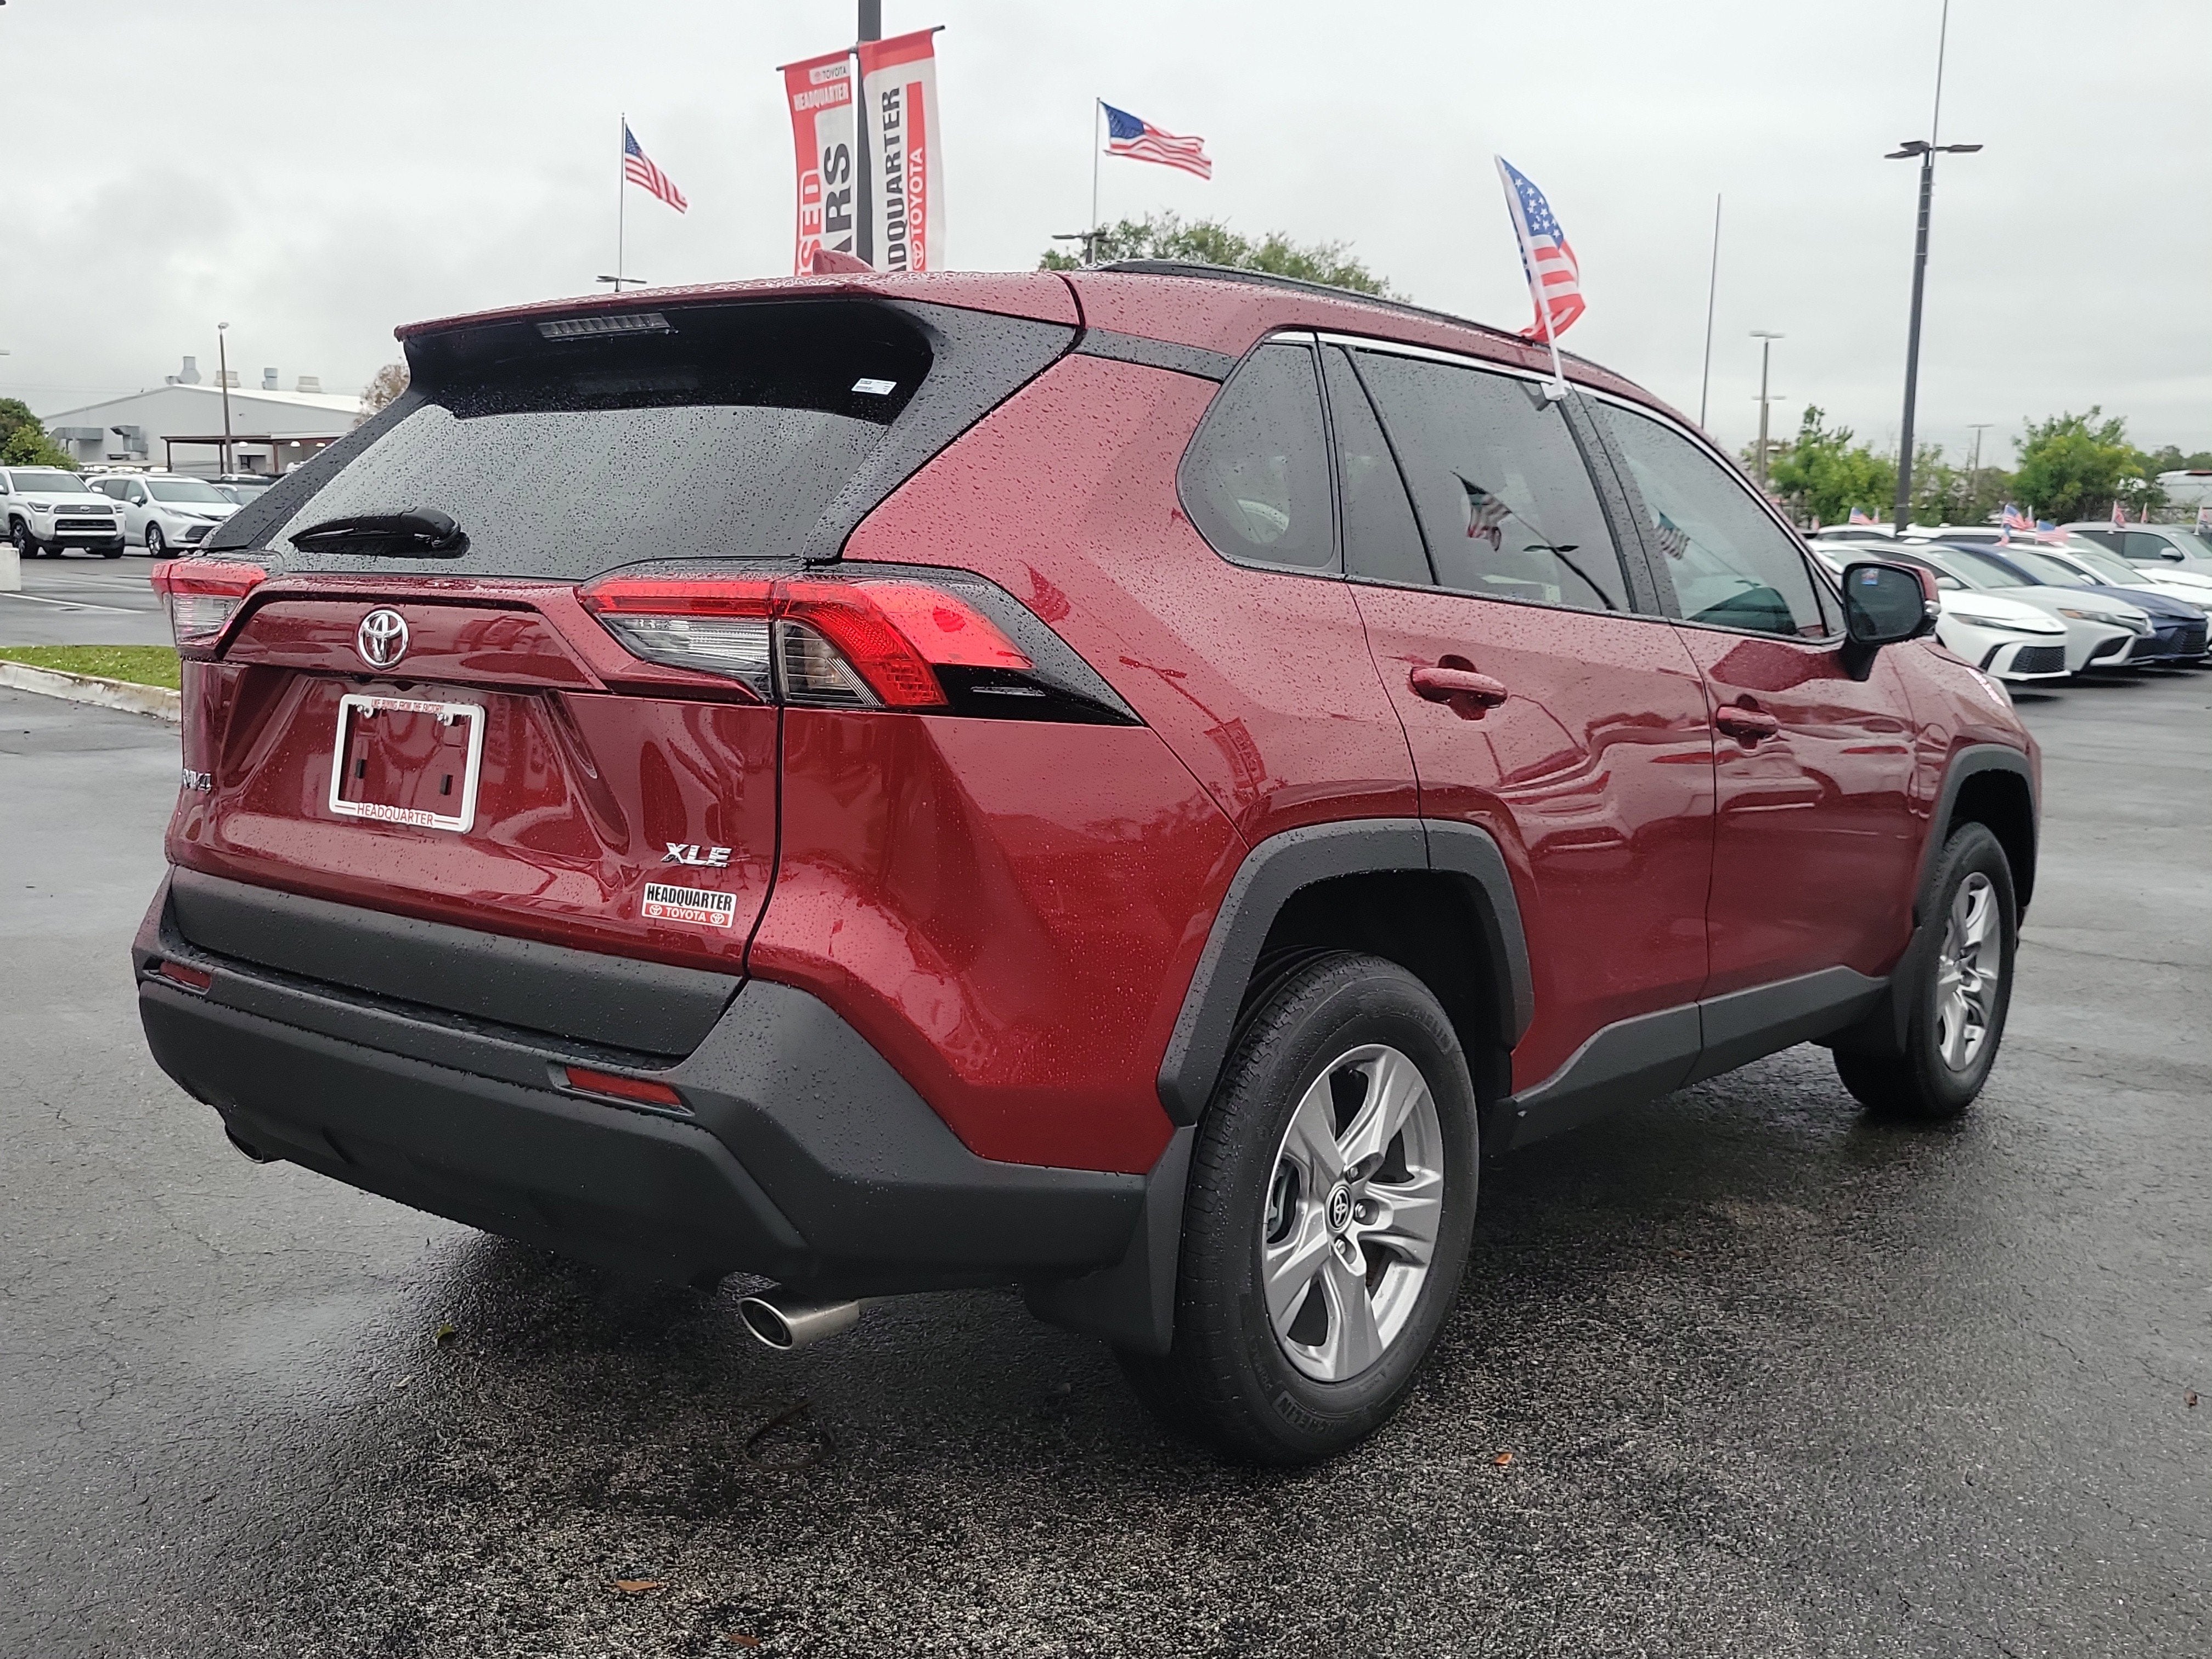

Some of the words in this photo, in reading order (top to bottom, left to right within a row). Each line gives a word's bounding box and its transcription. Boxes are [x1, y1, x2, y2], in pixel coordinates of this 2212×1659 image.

[822, 66, 847, 79] TOYOTA
[909, 146, 923, 239] TOYOTA
[801, 173, 821, 277] SED
[357, 803, 433, 826] HEADQUARTER
[660, 842, 732, 868] XLE
[646, 884, 732, 911] HEADQUARTER
[665, 907, 707, 922] TOYOTA
